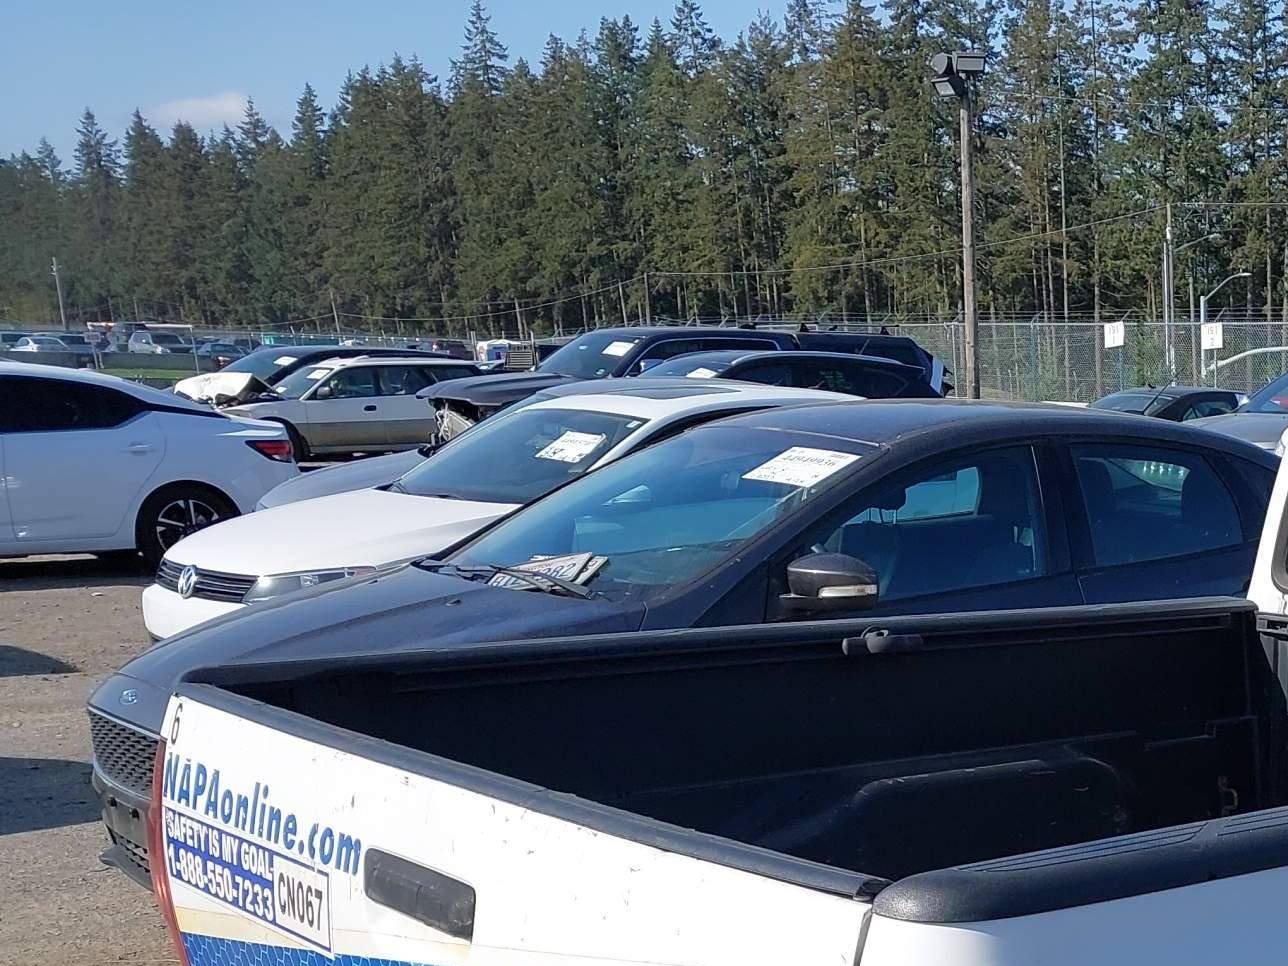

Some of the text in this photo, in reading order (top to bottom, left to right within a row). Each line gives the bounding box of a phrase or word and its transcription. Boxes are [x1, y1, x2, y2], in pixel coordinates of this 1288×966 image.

[170, 703, 183, 745] 6
[163, 752, 362, 877] NAPAonline.com
[166, 811, 208, 853] SAFETY
[208, 826, 220, 858] IS
[221, 833, 240, 867] MY
[167, 843, 274, 922] 1-888-550-7233
